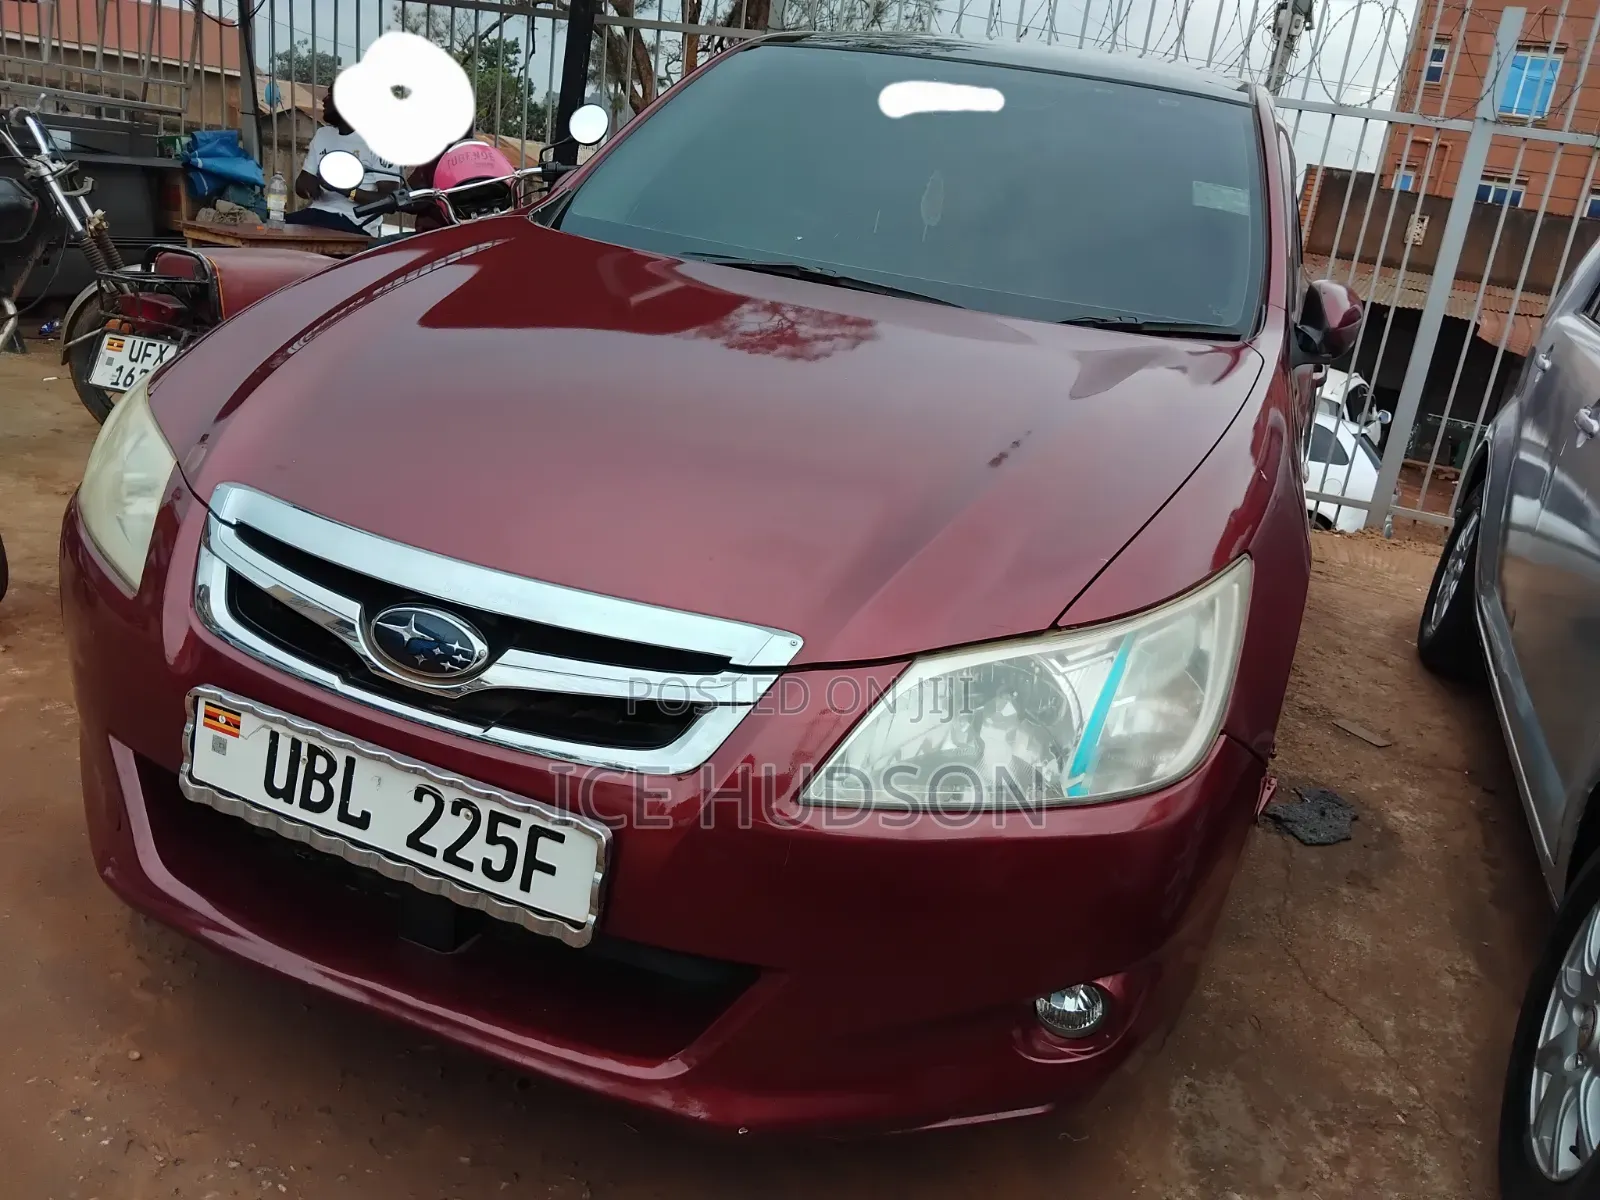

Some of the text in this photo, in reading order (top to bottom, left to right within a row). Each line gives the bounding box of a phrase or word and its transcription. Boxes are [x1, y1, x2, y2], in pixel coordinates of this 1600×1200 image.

[129, 340, 169, 366] UFX
[263, 730, 566, 893] UBL 225F
